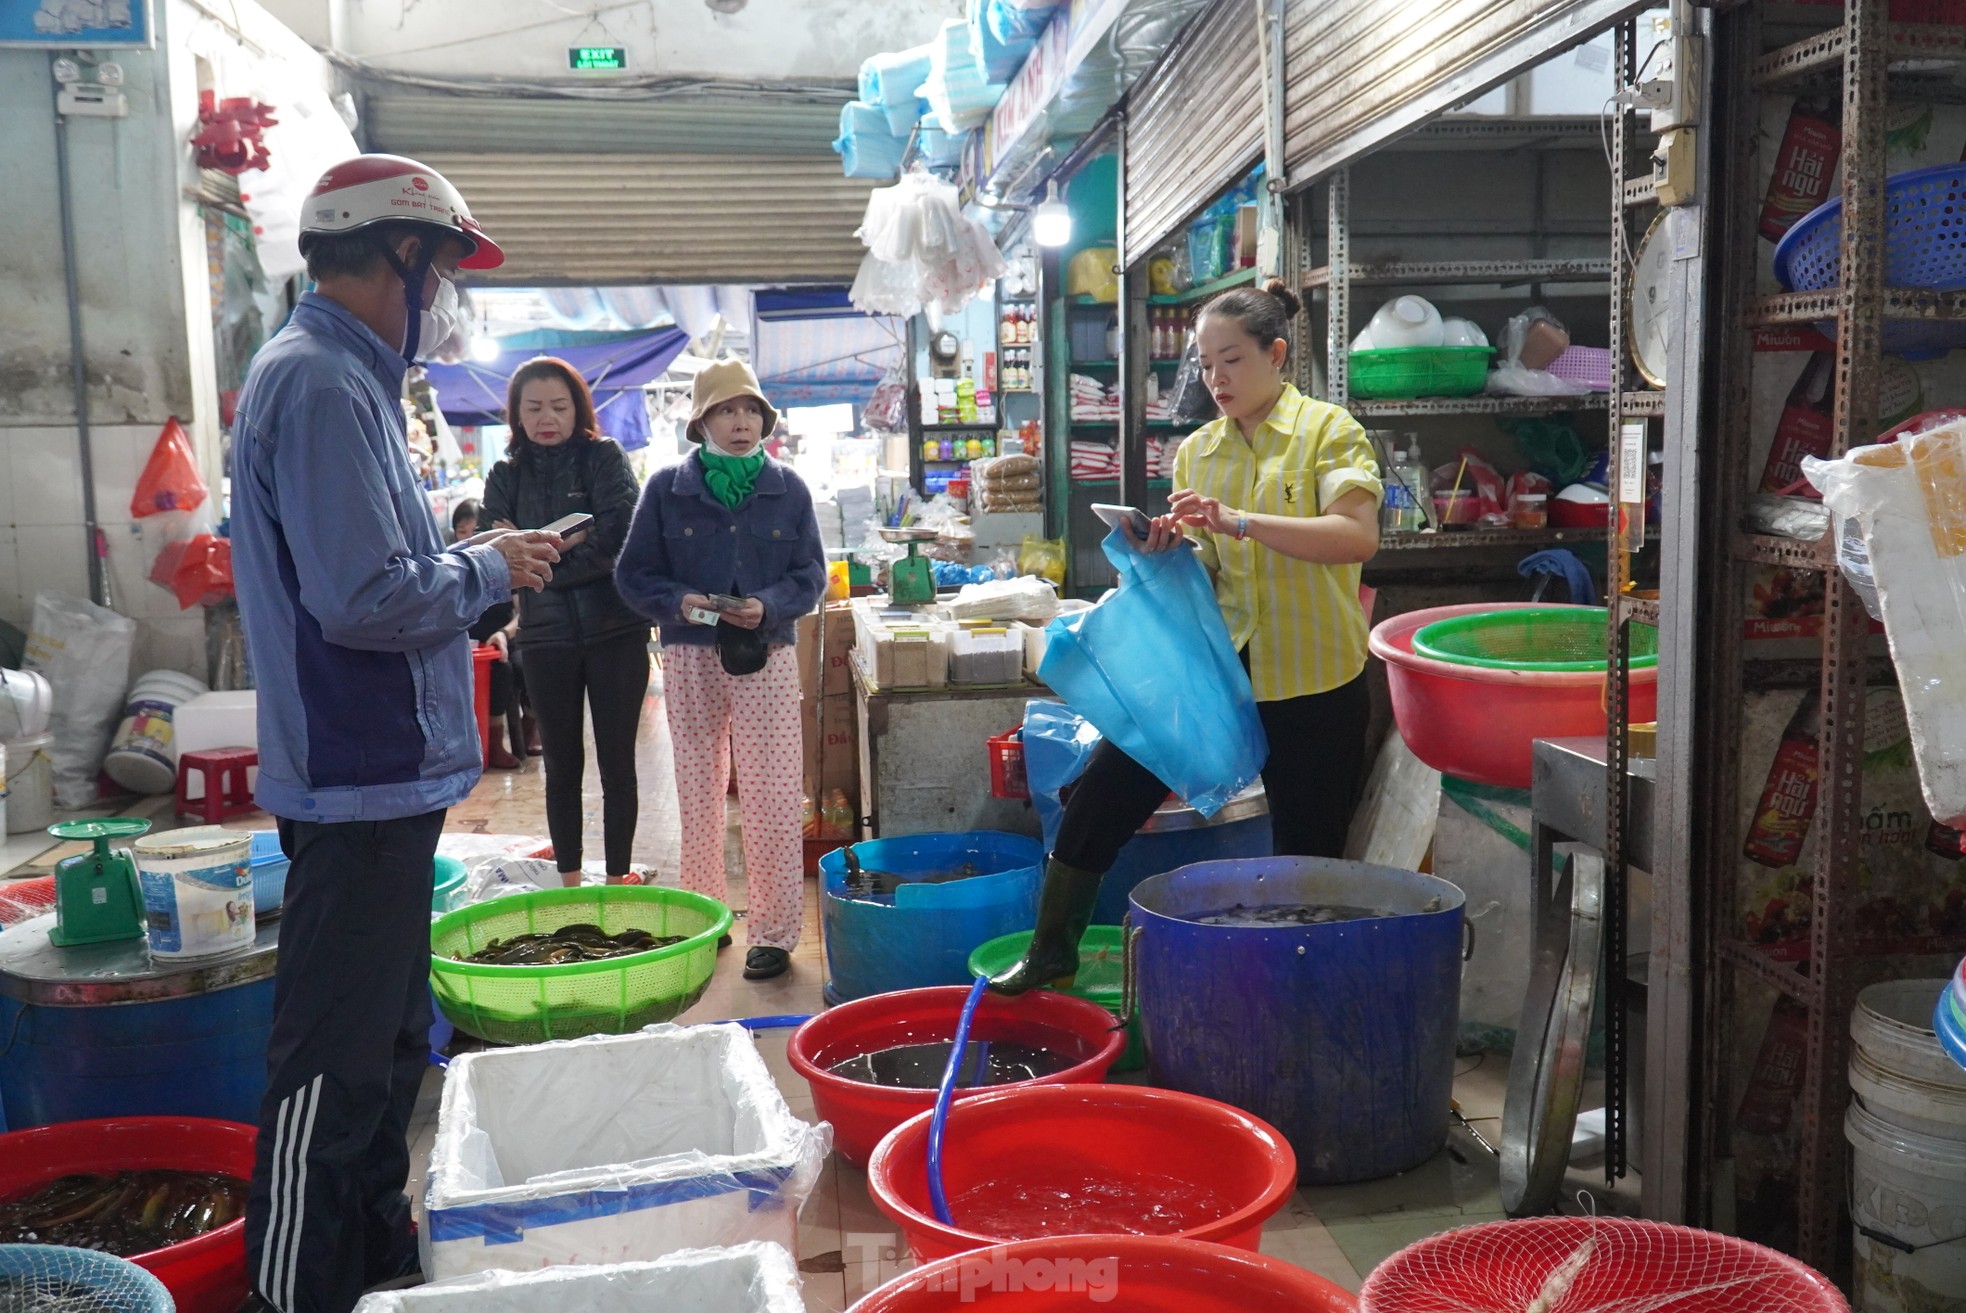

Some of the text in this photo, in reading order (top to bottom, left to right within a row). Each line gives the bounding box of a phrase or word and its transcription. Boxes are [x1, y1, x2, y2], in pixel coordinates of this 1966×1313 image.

[1788, 145, 1825, 178] Hải
[1782, 169, 1824, 197] ngư
[1756, 334, 1801, 346] Miwon
[1753, 621, 1799, 634] Miwon
[1860, 802, 1912, 830] ấm
